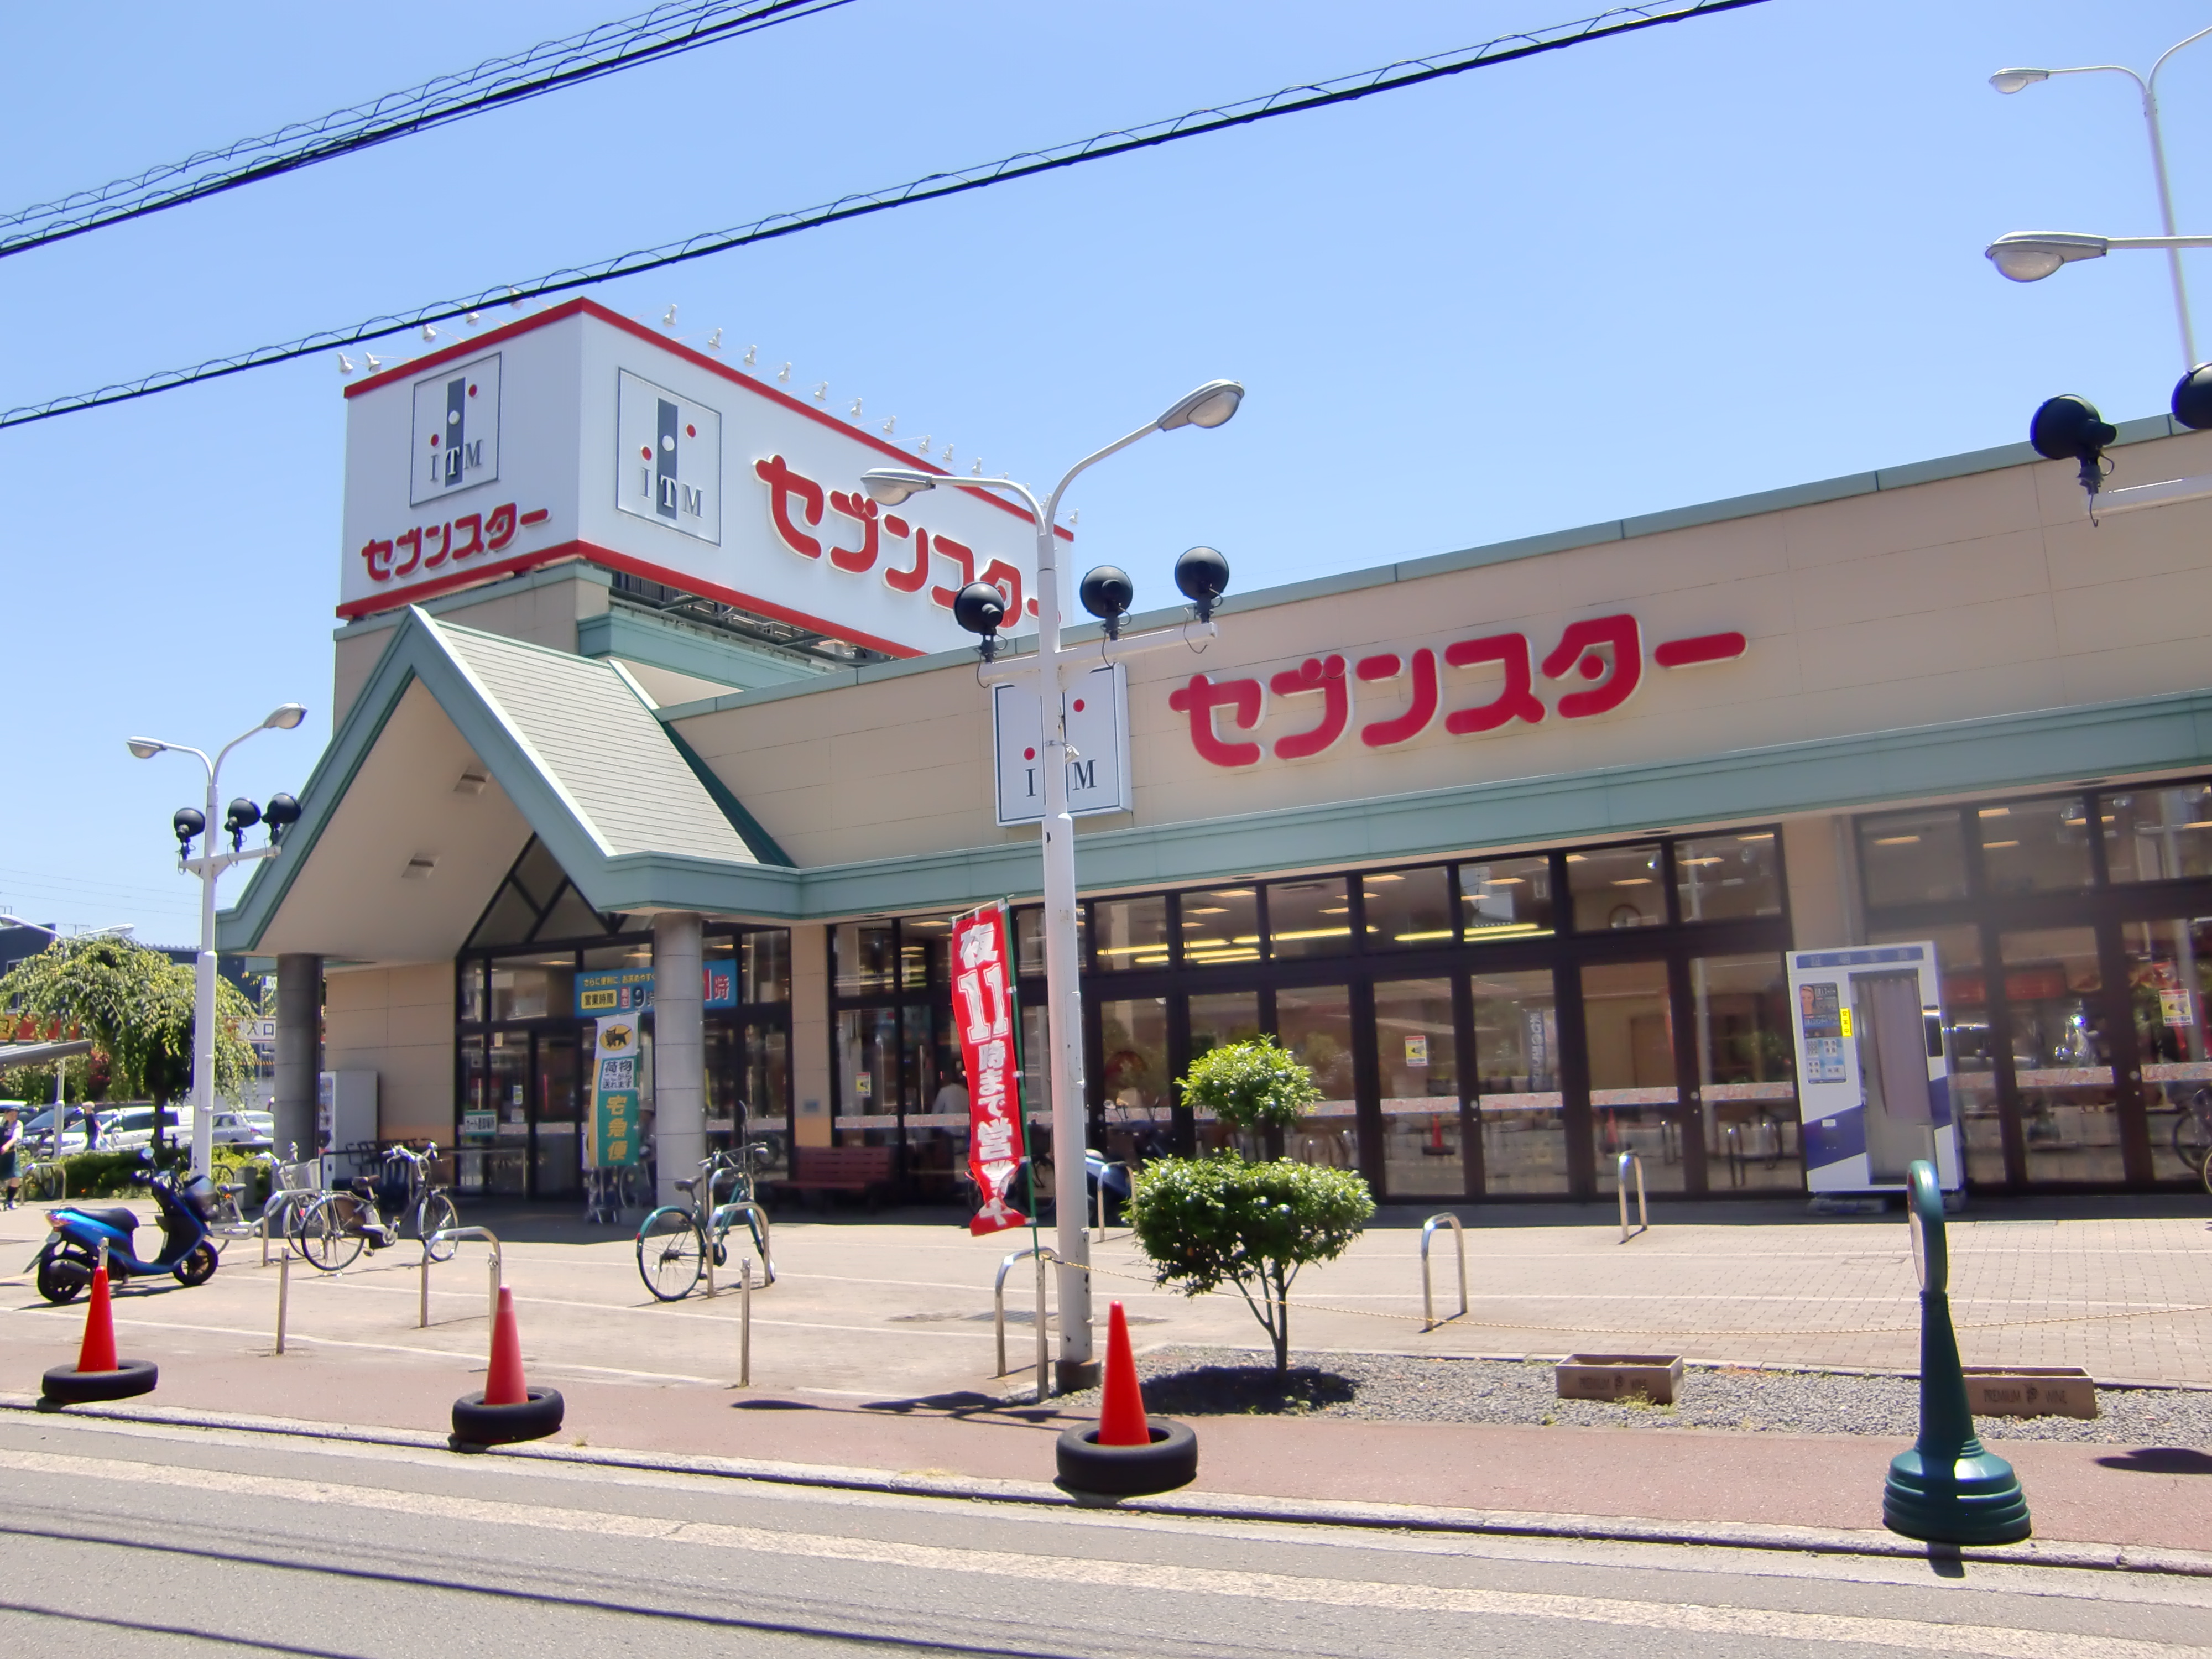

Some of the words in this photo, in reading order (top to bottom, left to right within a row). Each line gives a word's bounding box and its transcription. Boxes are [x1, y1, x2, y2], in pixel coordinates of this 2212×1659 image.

[430, 440, 483, 482] ITM
[640, 467, 704, 519] ITM
[361, 502, 552, 582] セブンスター
[1168, 613, 1749, 768] セブンスター
[604, 1060, 633, 1073] 荷物
[606, 1094, 628, 1161] 宅急便
[1983, 1388, 2021, 1403] PREMIUM
[2046, 1390, 2068, 1404] WINE
